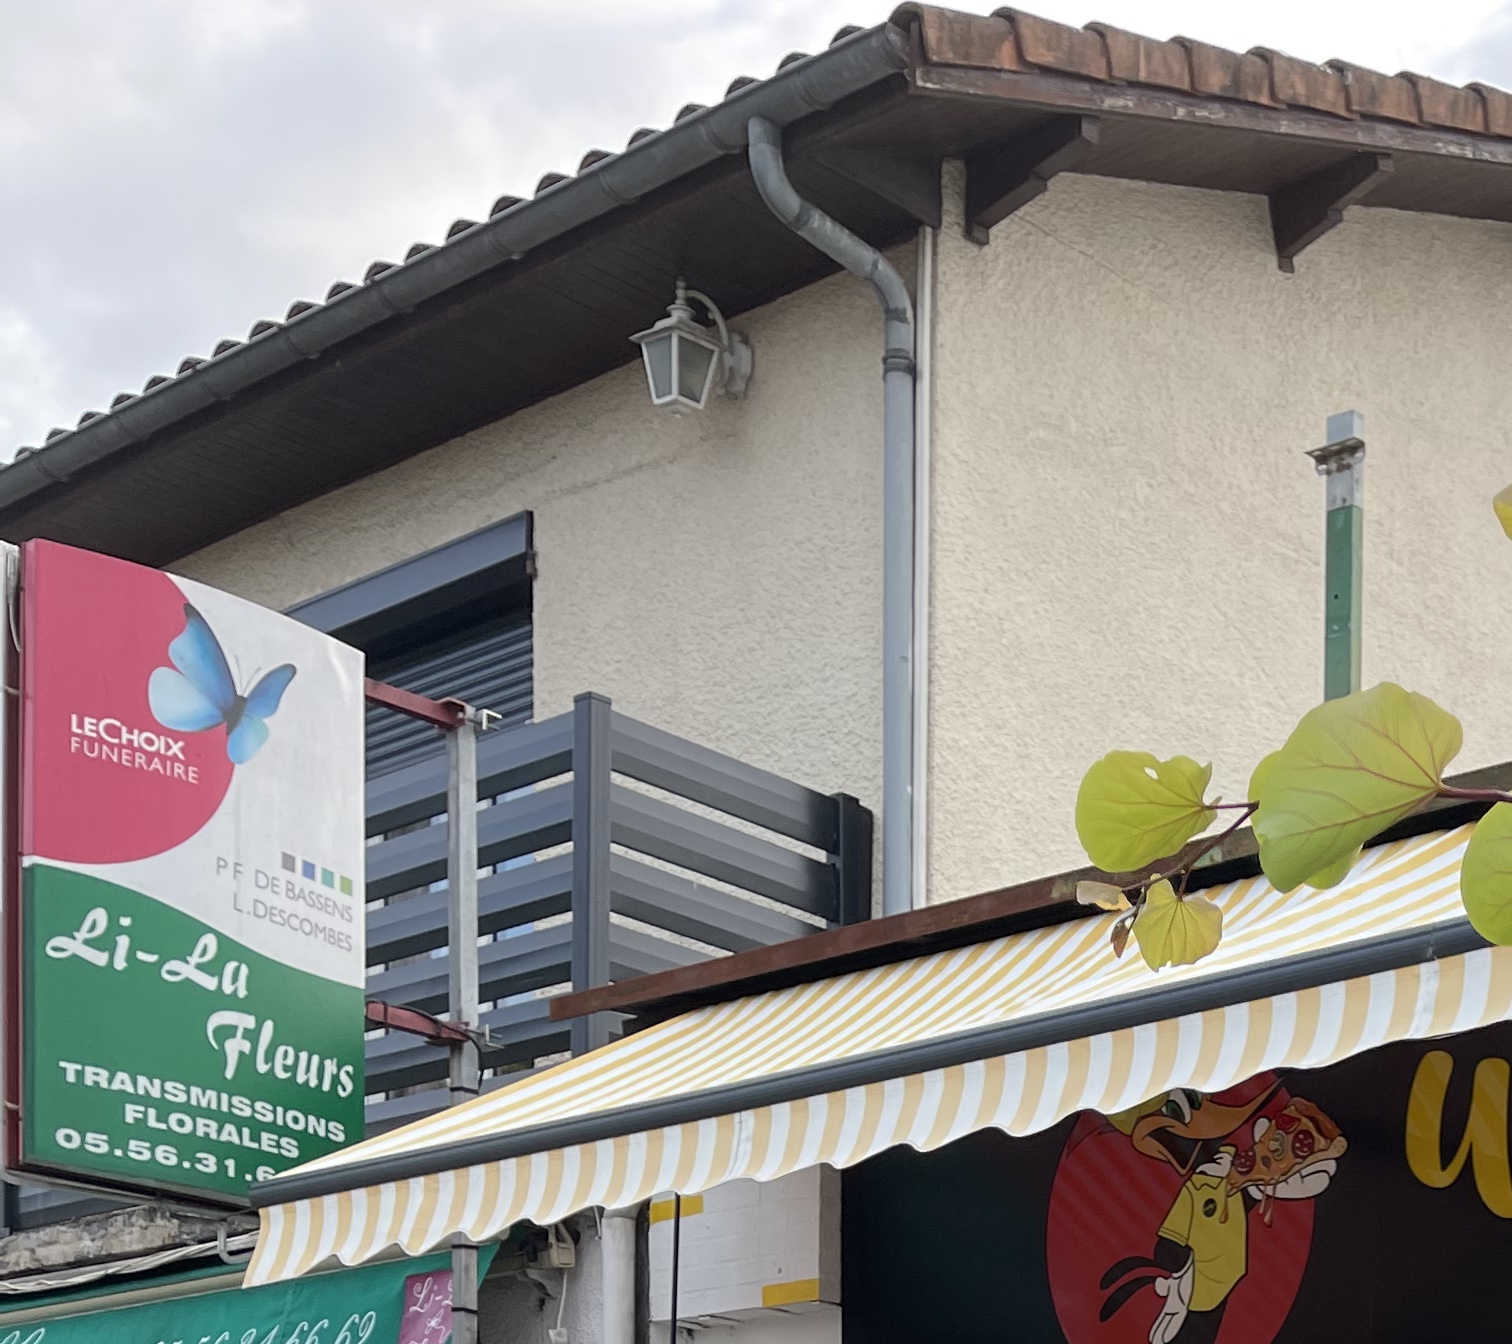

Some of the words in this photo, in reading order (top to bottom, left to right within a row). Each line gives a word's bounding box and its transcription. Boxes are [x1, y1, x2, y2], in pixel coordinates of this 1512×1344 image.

[70, 736, 200, 785] FUNERAIRE
[233, 862, 244, 881] F
[254, 869, 280, 895] DE
[285, 881, 353, 923] BASSENS
[45, 906, 249, 999] Li-La
[206, 1010, 354, 1098] Fleurs
[58, 1060, 346, 1143] TRANSMISSIONS
[124, 1102, 300, 1160] FLORALES
